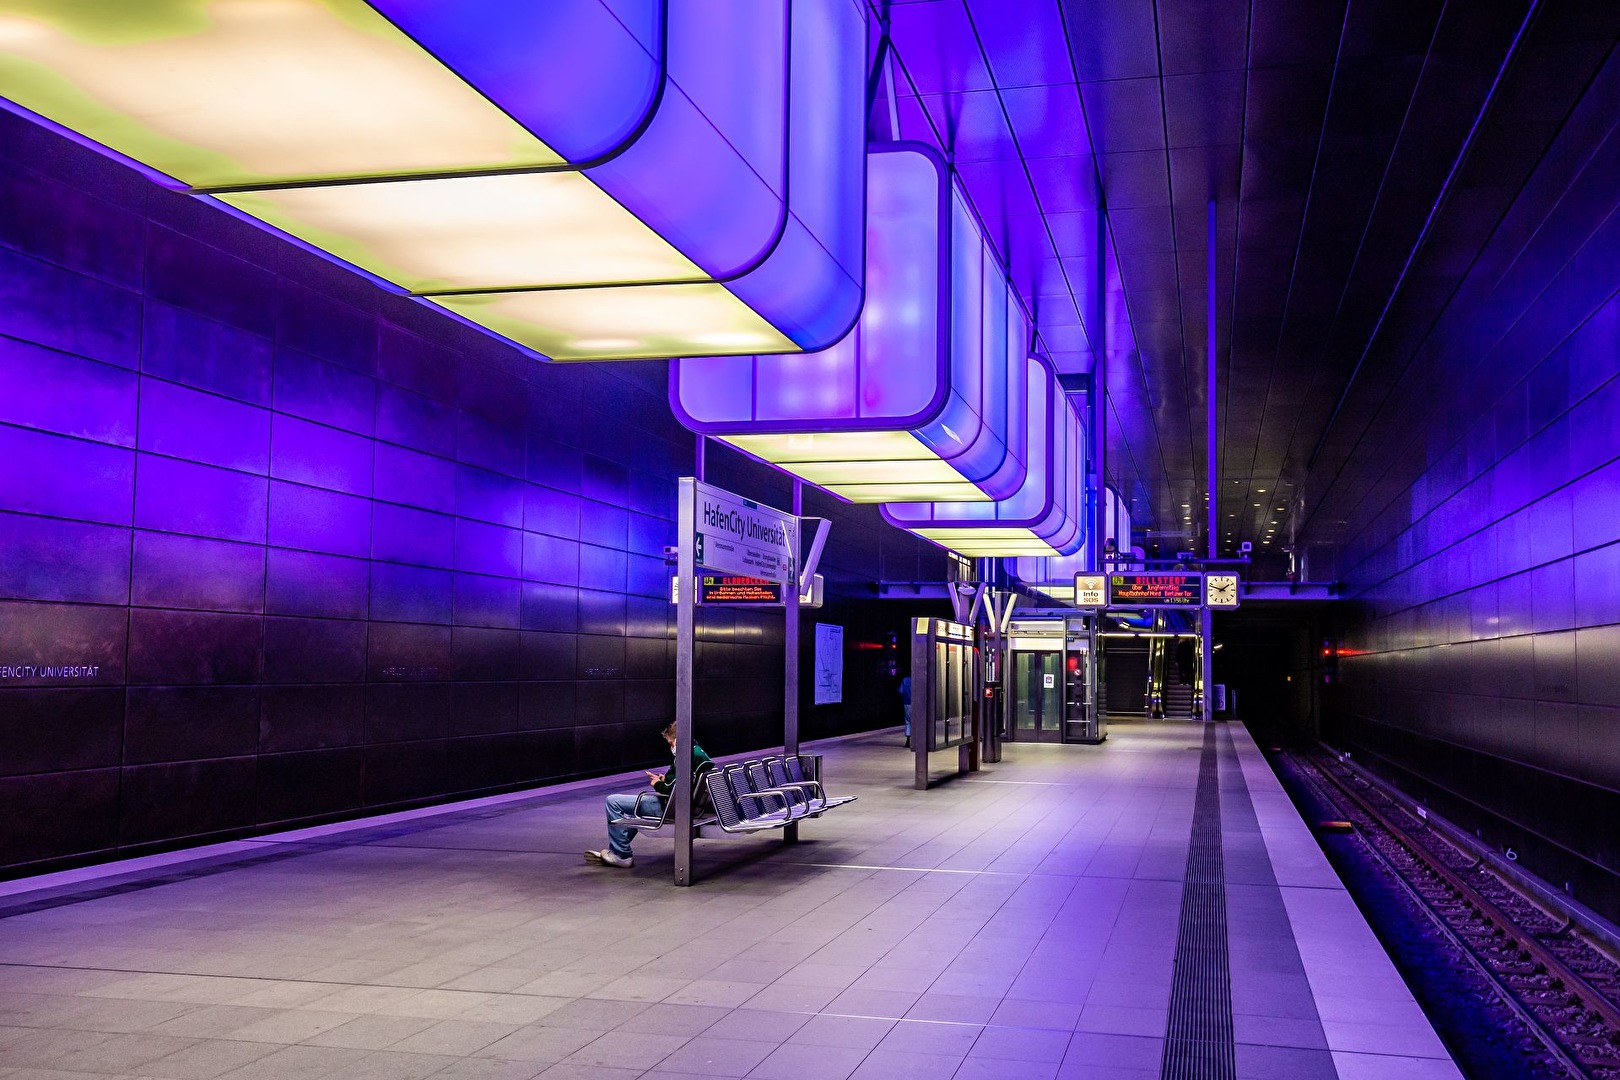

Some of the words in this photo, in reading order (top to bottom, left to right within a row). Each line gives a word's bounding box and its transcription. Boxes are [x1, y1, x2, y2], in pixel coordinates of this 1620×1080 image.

[704, 501, 746, 541] HafenCity
[1135, 576, 1186, 585] BILLSTEDT
[40, 664, 99, 678] UNIVERSITÄT
[1506, 847, 1518, 861] 6
